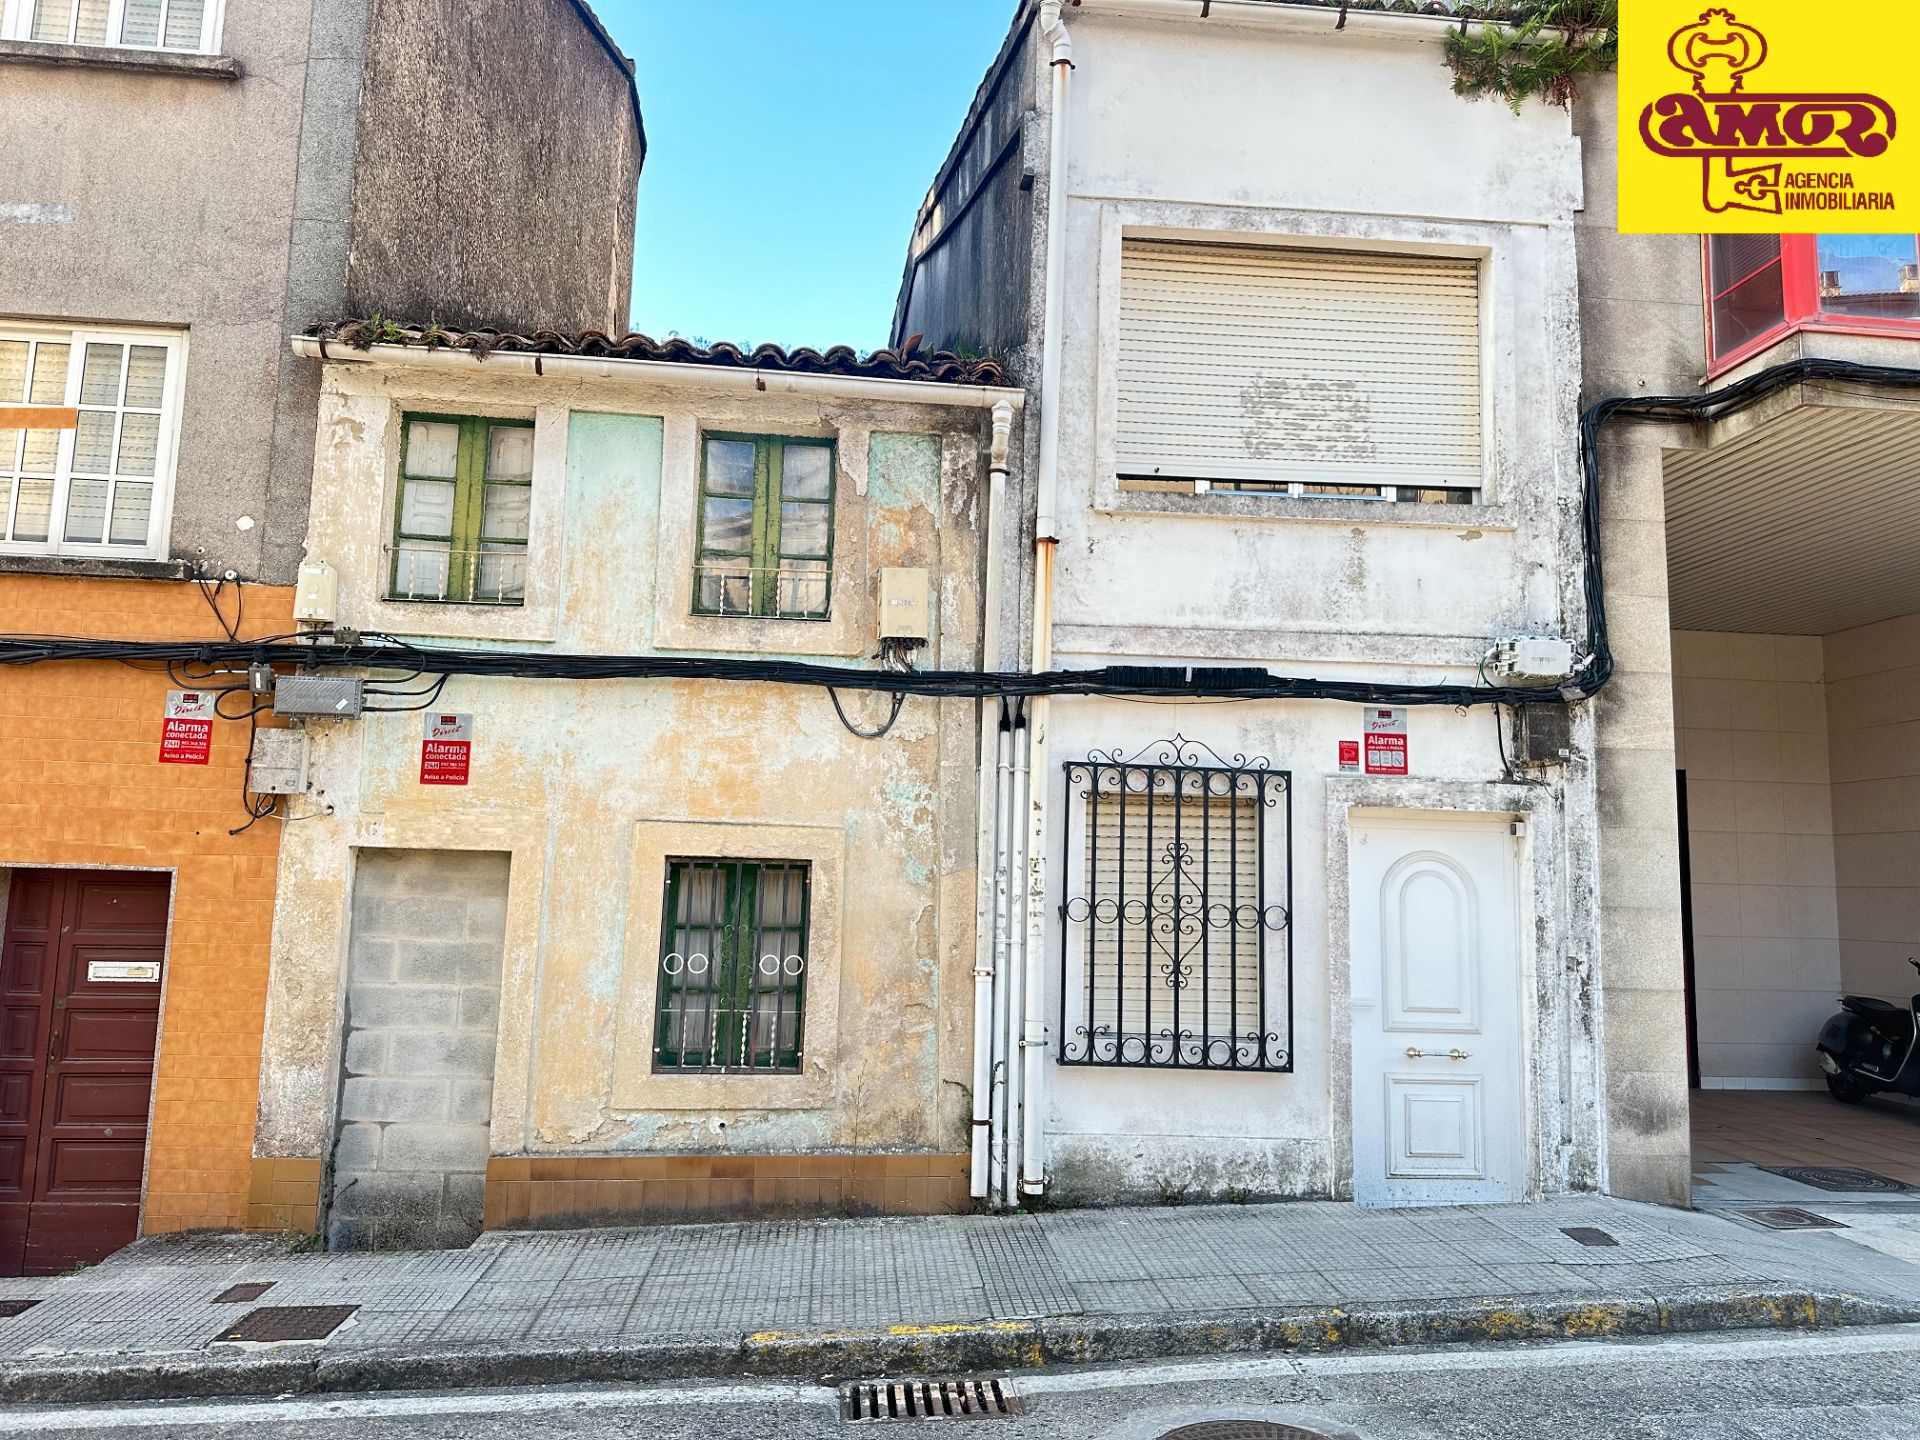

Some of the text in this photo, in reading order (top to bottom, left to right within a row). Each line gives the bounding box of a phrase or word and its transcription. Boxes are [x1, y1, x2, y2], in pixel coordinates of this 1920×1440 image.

[174, 703, 205, 715] Direct
[166, 721, 208, 732] Alarma
[1371, 719, 1399, 730] Direct
[165, 731, 208, 740] conectada
[432, 725, 464, 737] Direct
[1367, 734, 1404, 746] Alarma
[425, 743, 467, 753] Alarma
